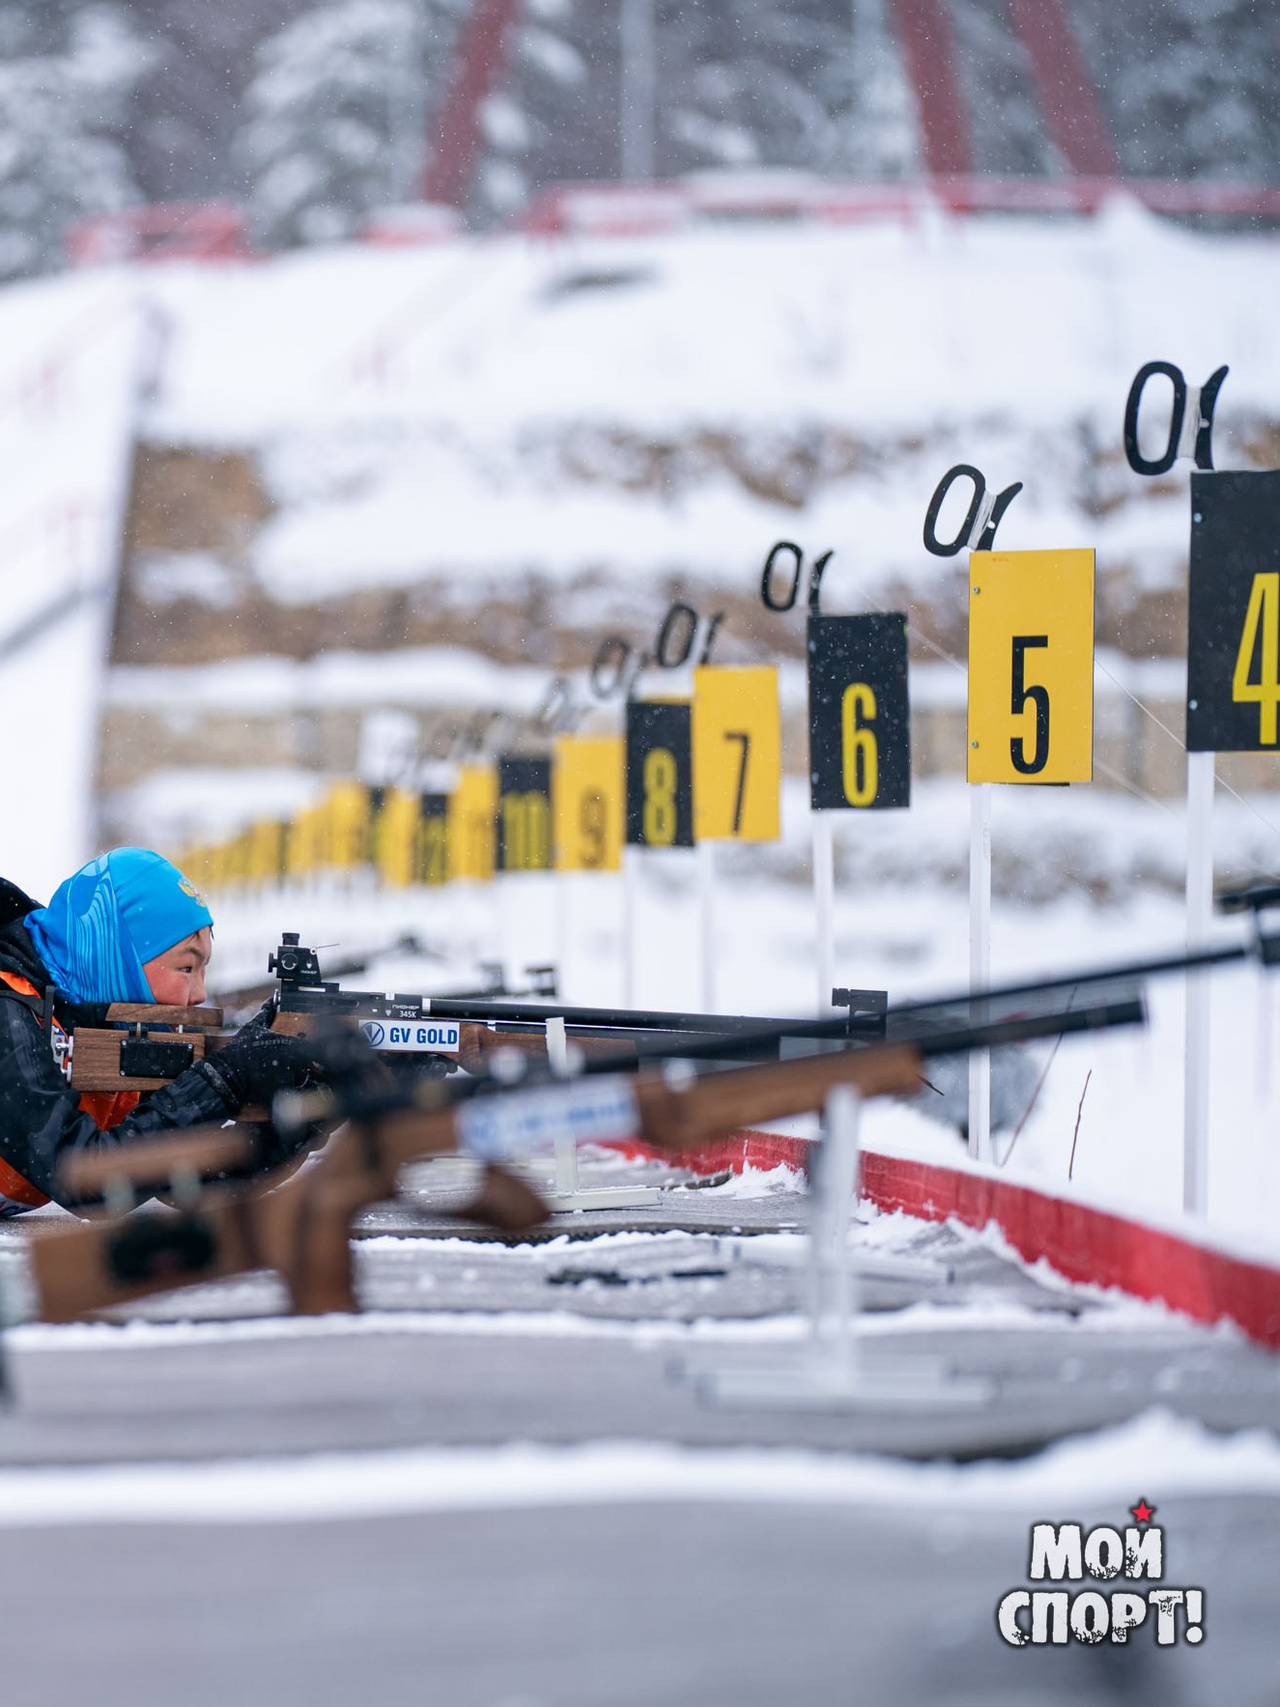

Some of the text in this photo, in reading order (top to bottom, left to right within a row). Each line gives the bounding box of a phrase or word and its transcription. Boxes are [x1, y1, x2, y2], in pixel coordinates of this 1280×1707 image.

[1009, 635, 1050, 774] 5
[1231, 572, 1280, 745] 4
[641, 747, 678, 847] 8
[723, 731, 750, 836] 7
[840, 682, 878, 808] 6
[579, 785, 609, 869] 9
[389, 1026, 458, 1045] GV GOLD
